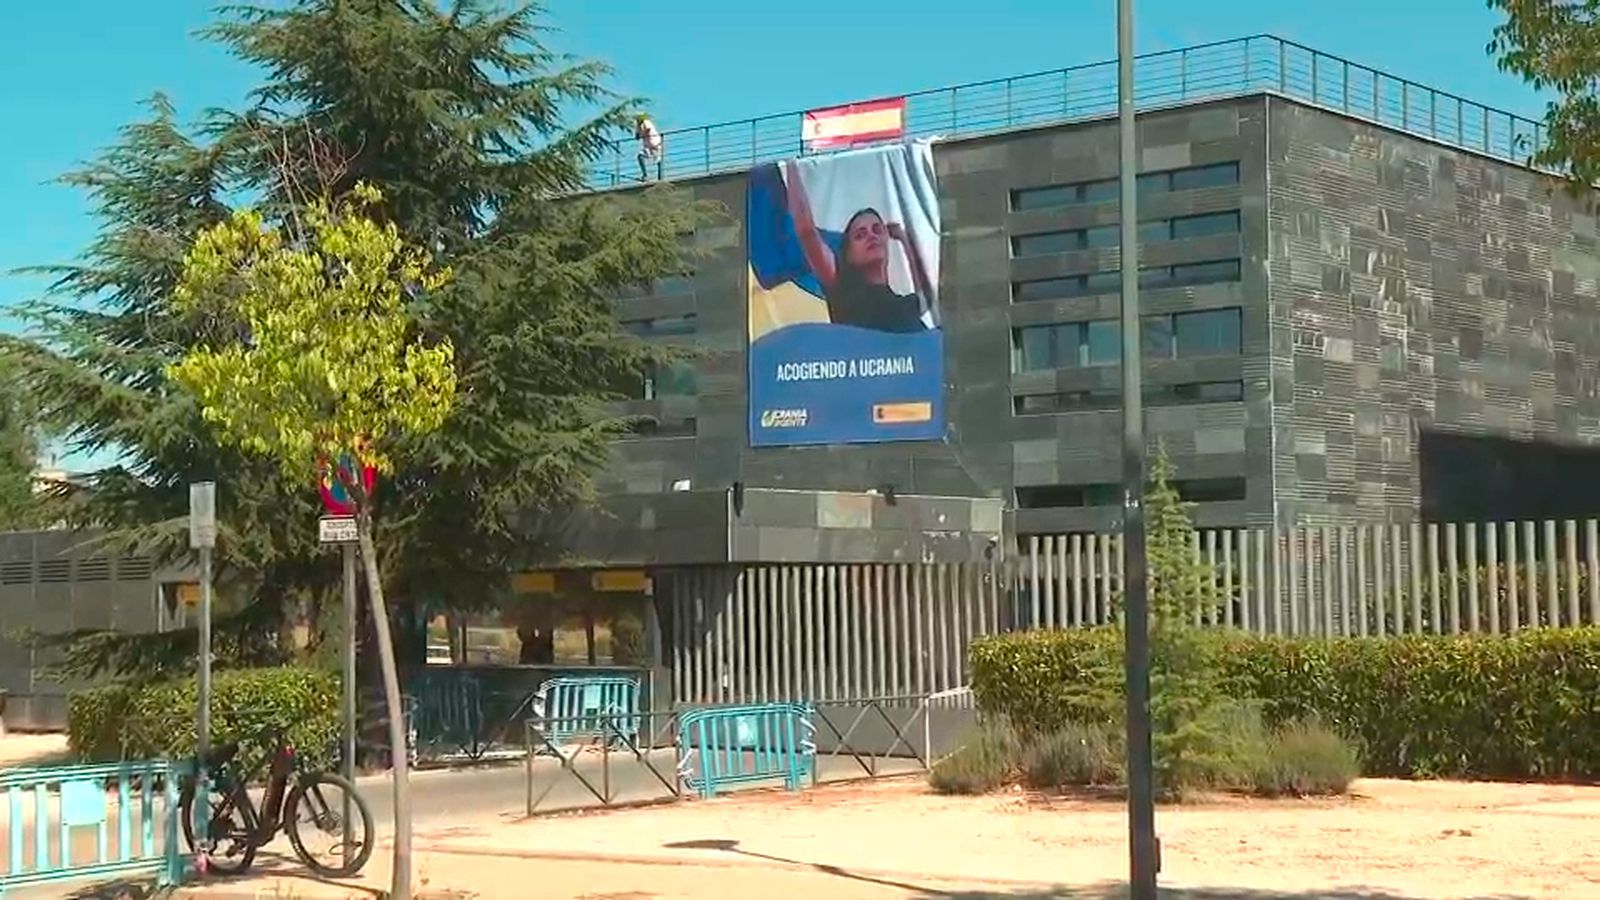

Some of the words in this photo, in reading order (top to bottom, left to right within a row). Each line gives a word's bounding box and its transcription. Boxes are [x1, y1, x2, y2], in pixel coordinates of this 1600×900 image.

[776, 360, 847, 381] ACOGIENDO
[848, 360, 857, 377] A
[859, 356, 914, 377] UCRANIA
